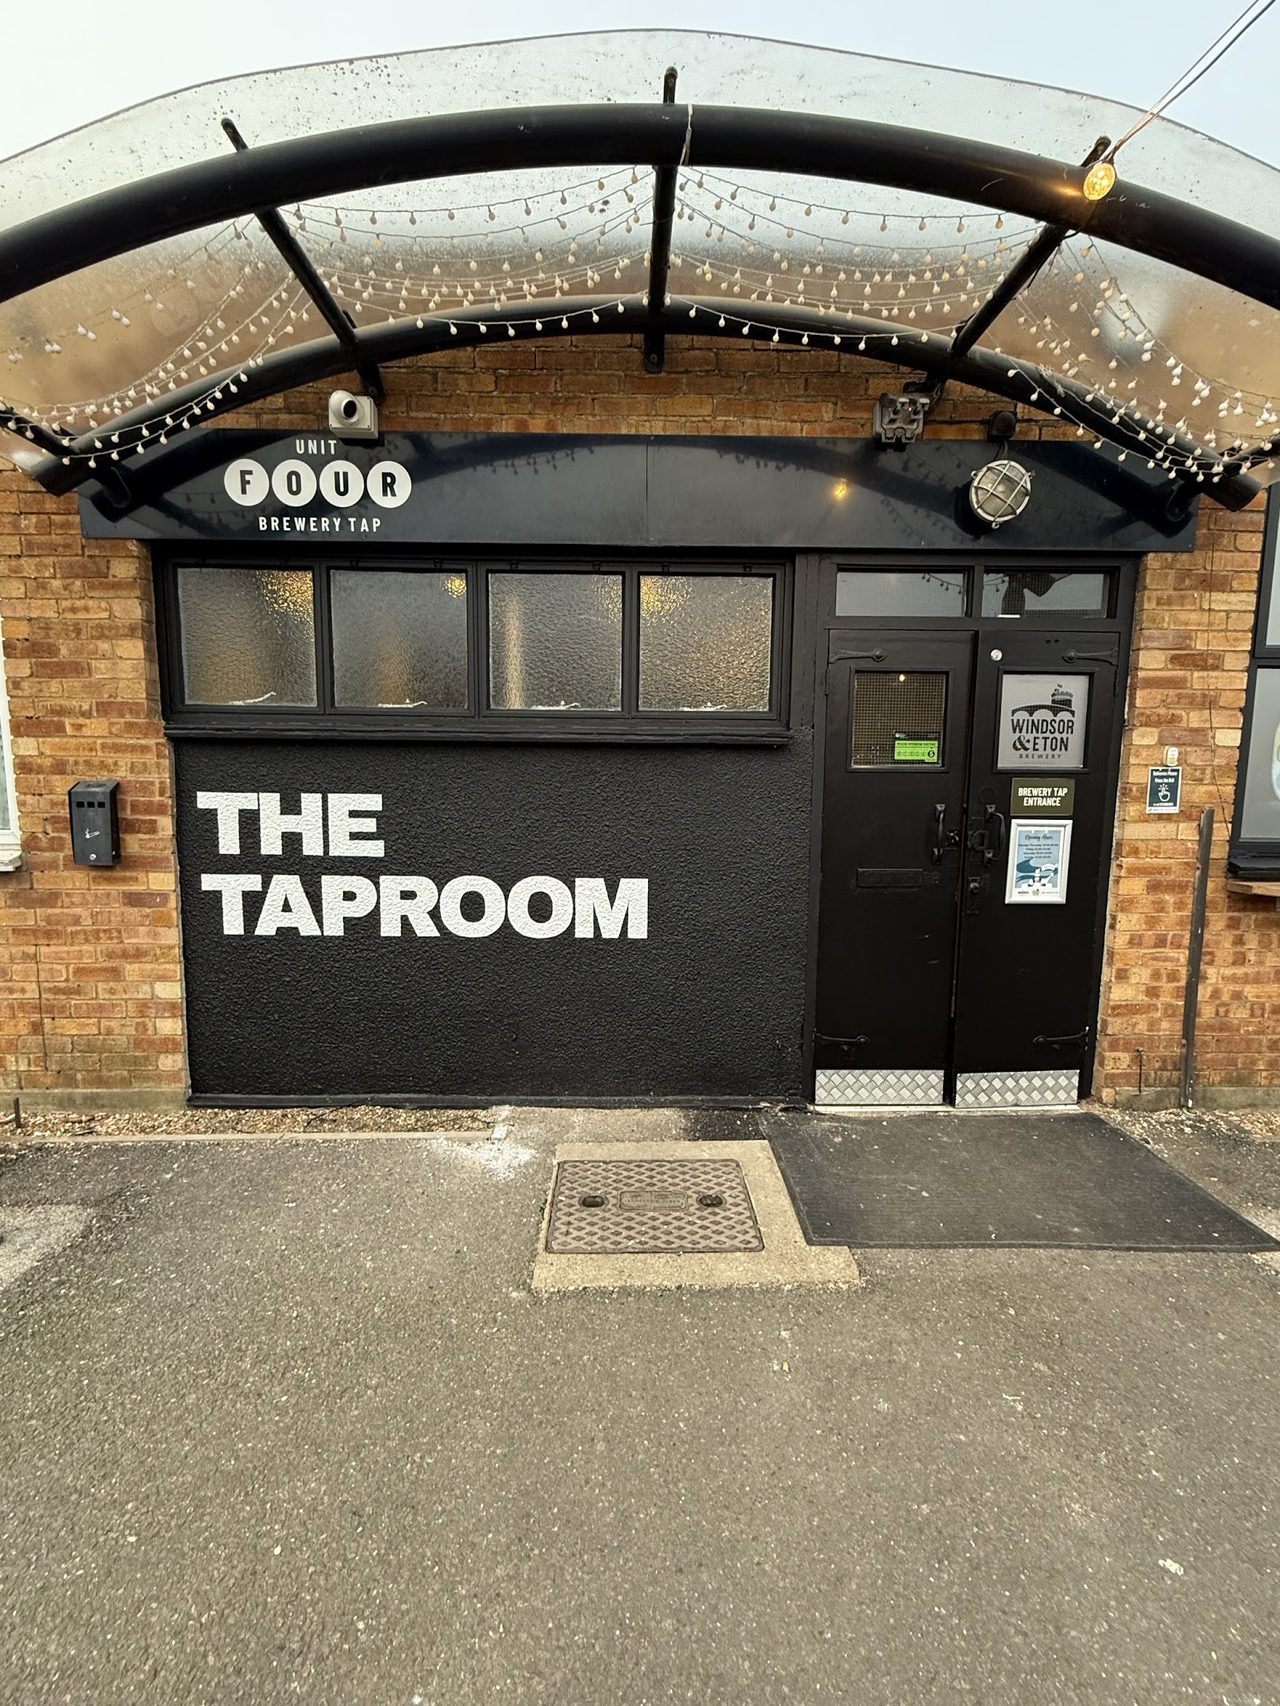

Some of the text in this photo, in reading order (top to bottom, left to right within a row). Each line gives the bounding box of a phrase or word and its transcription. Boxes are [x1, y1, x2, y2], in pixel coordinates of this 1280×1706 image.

[295, 439, 337, 455] UNIT
[237, 467, 399, 500] FOUR
[258, 516, 382, 533] BREWERY TAP
[1011, 718, 1075, 735] WINDSOR
[1018, 787, 1068, 797] BREWERY TAP
[1023, 797, 1061, 807] ENTRANCE
[196, 791, 385, 857] THE
[200, 873, 649, 939] TAPROOM
